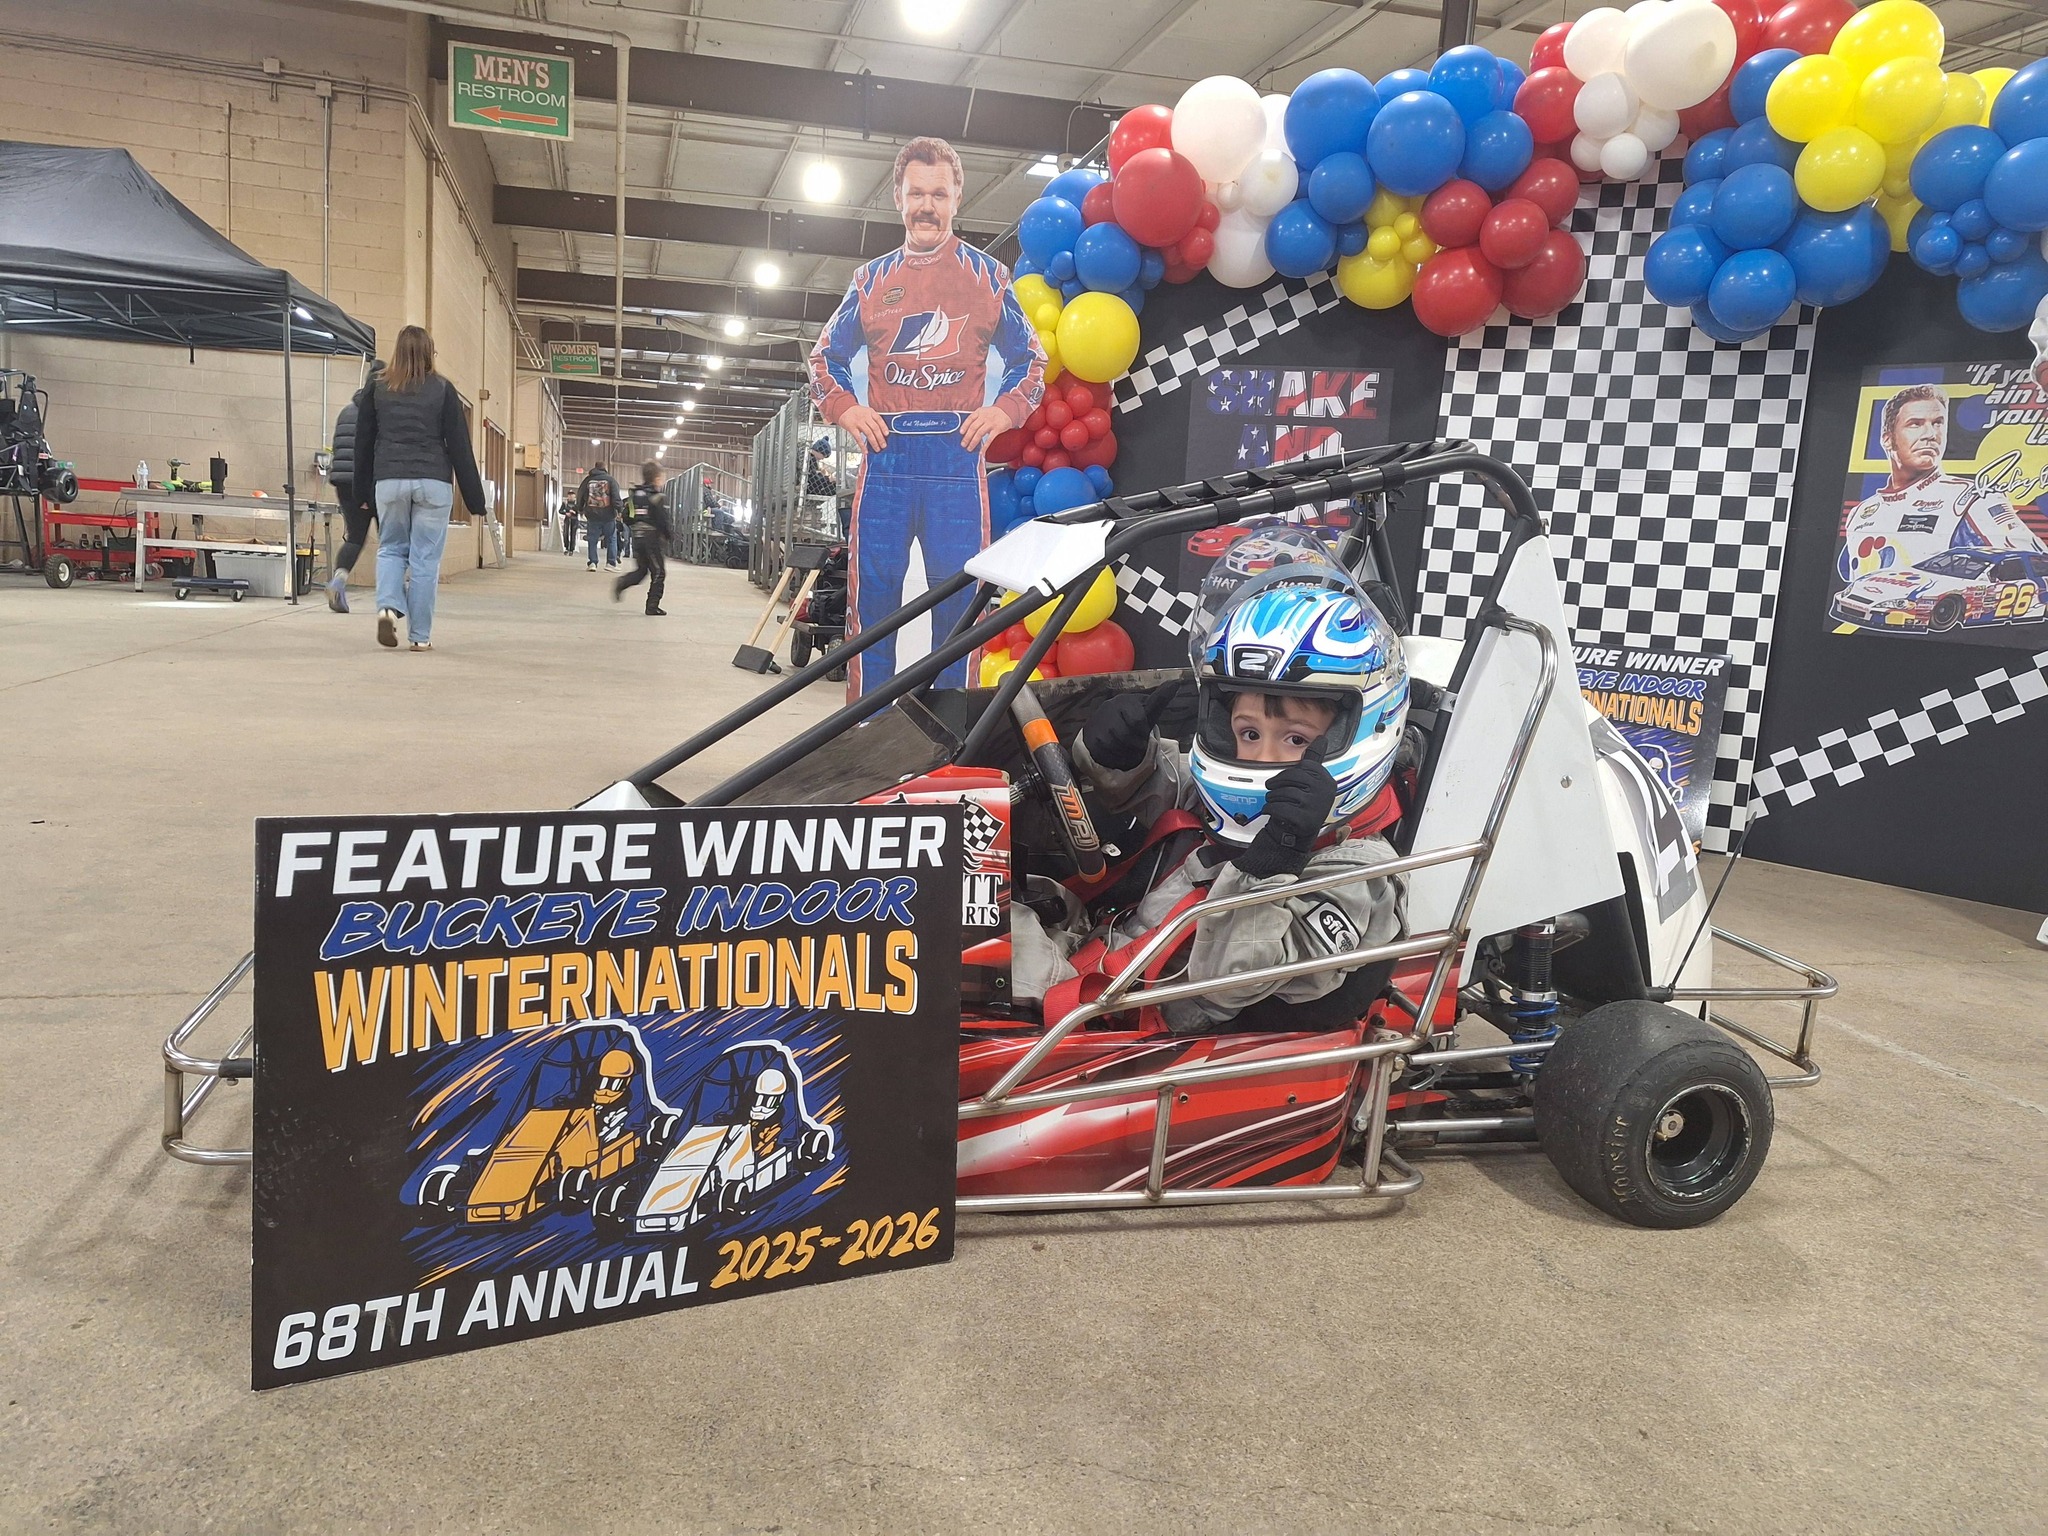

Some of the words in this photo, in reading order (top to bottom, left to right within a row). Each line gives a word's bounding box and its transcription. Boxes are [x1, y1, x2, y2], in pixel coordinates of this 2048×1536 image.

[474, 54, 550, 89] MEN'S
[458, 82, 566, 108] RESTROOM
[551, 344, 597, 355] WOMEN'S
[884, 361, 914, 385] Old
[914, 364, 966, 391] Spice
[1994, 368, 2031, 389] yo
[1207, 369, 1380, 420] SHAKE
[1994, 584, 2036, 618] 26
[1624, 651, 1725, 677] WINNER
[1618, 672, 1707, 700] INDOOR
[275, 821, 658, 898] FEATURE
[680, 815, 946, 878] WINNER
[319, 887, 668, 961] BUCKEYE
[676, 877, 918, 937] INDOOR
[313, 931, 919, 1073] WINTERNATIONALS
[272, 1295, 446, 1371] 68TH
[457, 1250, 699, 1338] ANNUAL
[708, 1207, 939, 1289] 2025-2026
